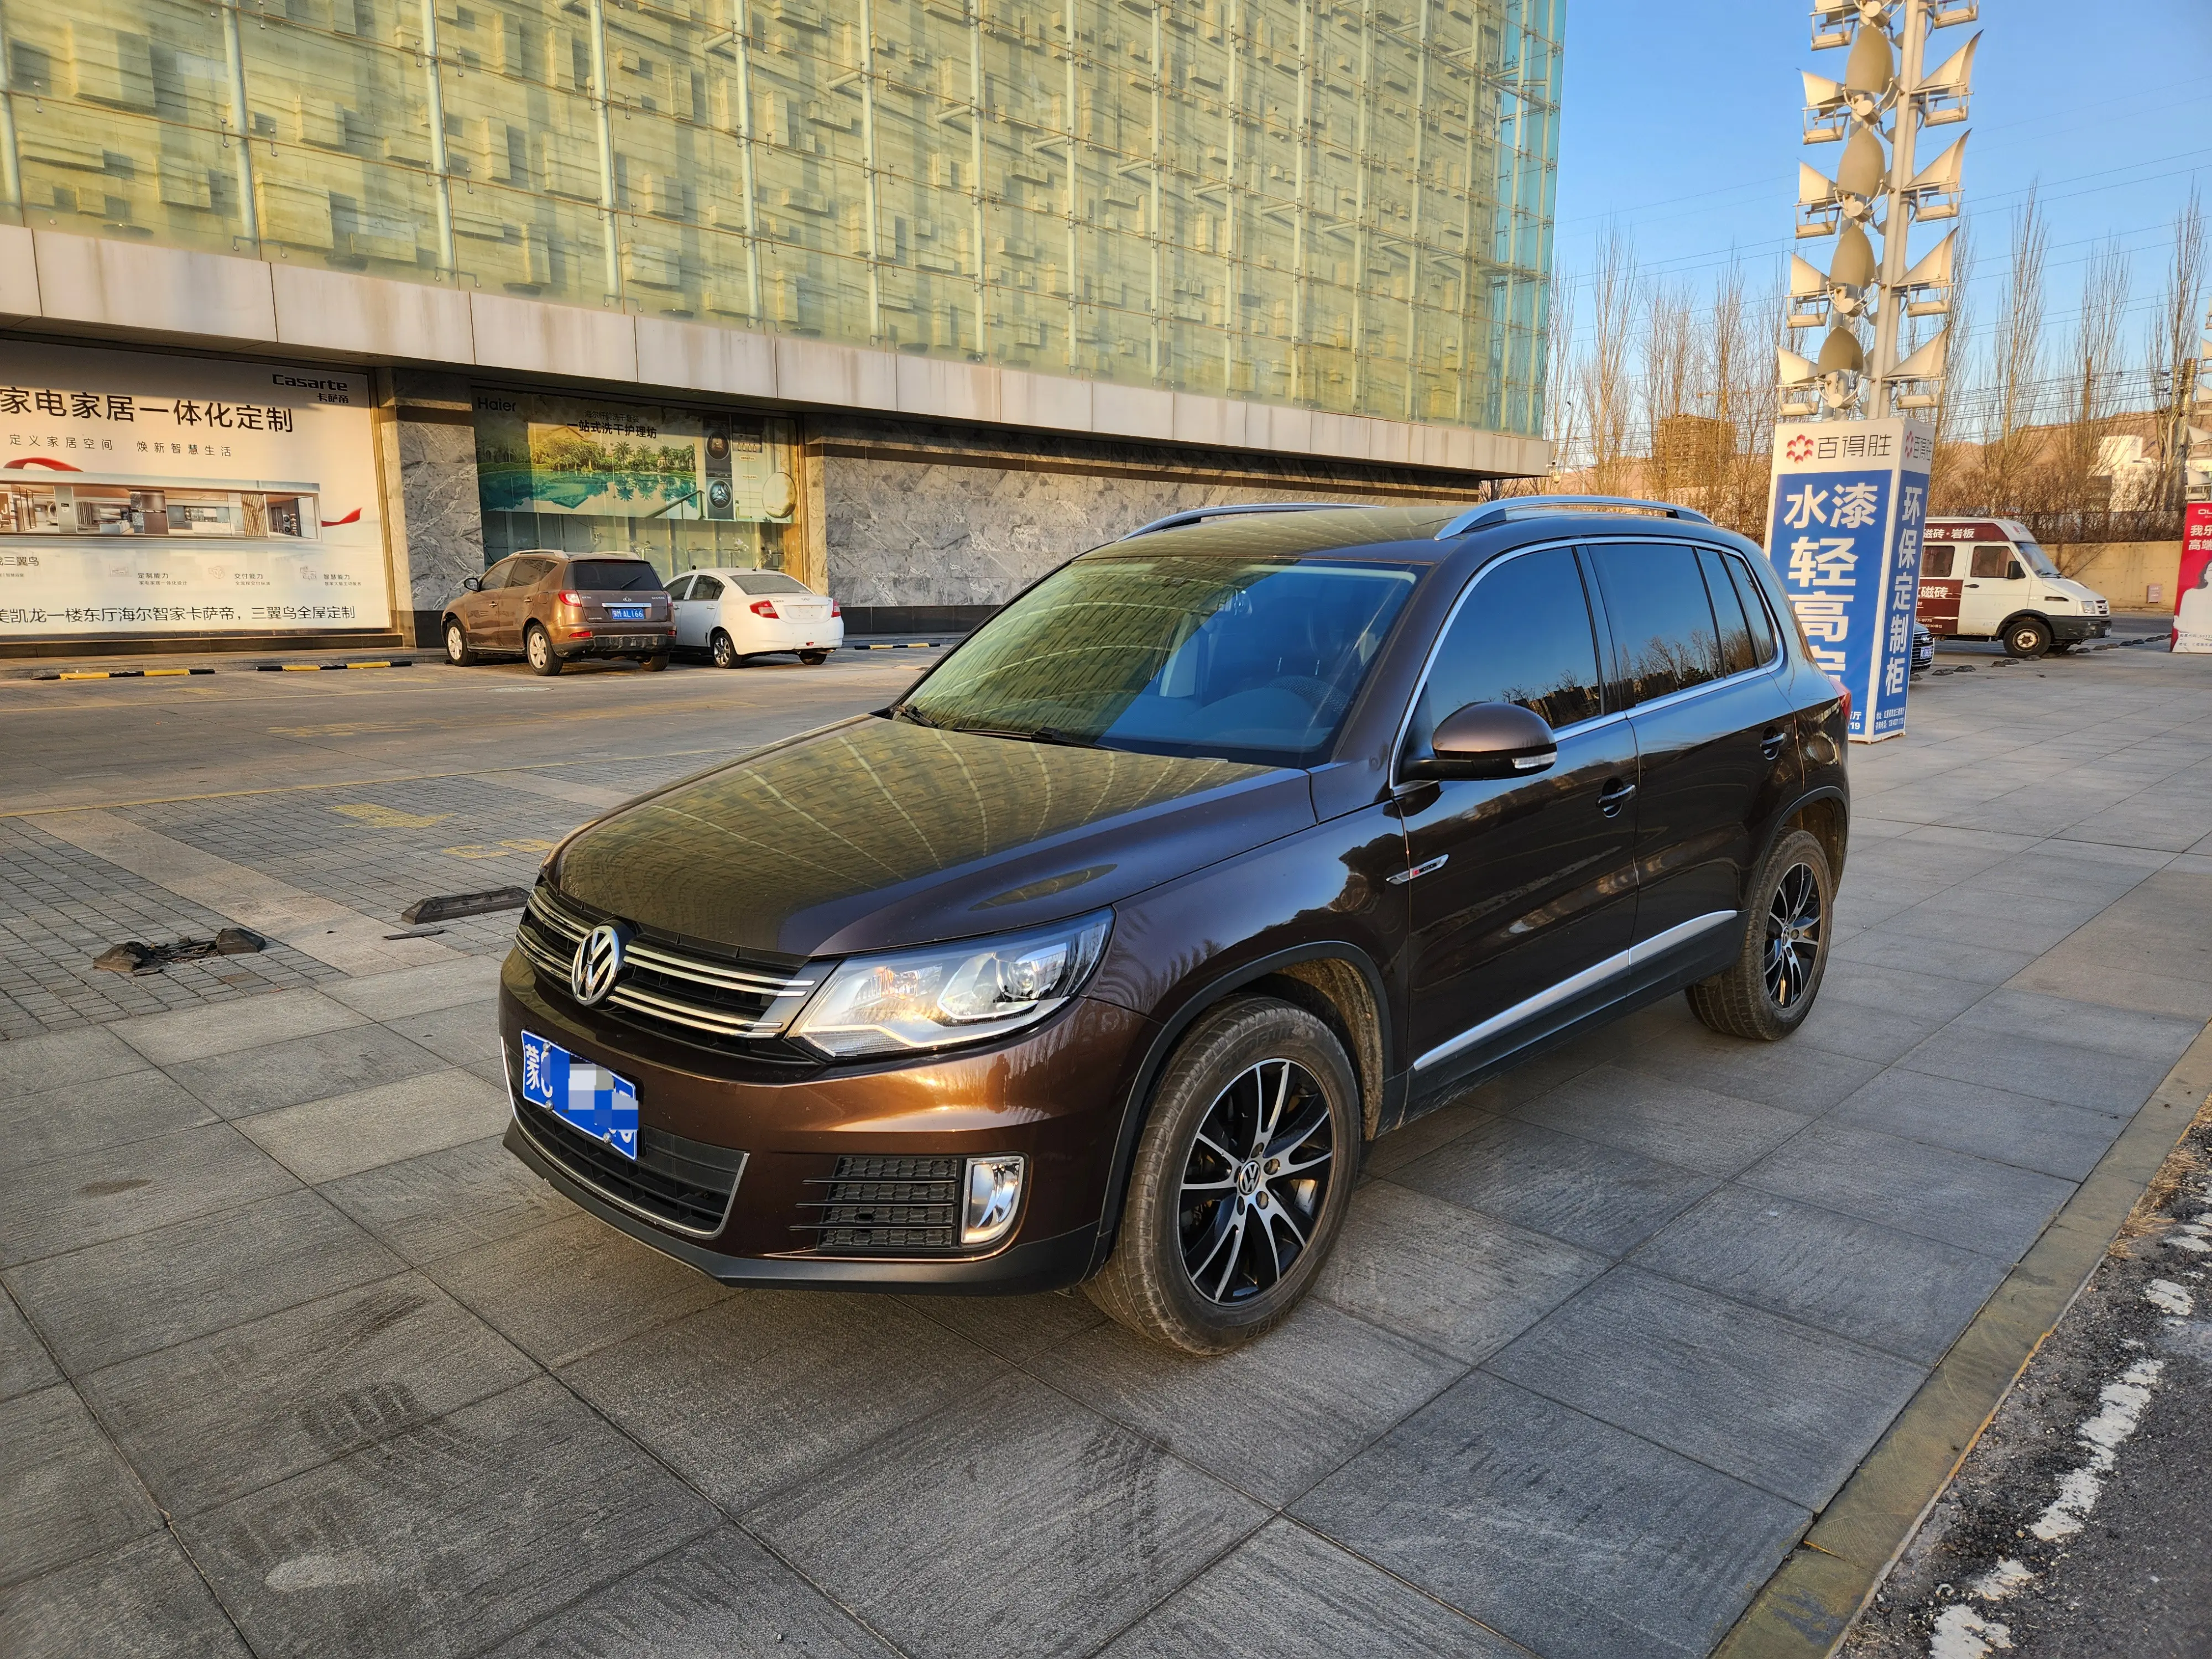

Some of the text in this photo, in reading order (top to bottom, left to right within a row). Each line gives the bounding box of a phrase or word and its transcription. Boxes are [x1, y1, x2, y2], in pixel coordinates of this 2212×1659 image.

[272, 374, 348, 391] Casarte
[0, 387, 293, 432] 家电家居一体化定制
[317, 393, 349, 404] 卡萨帝
[477, 397, 517, 412] Haier
[566, 419, 657, 439] 一站式洗干护理坊
[9, 434, 231, 457] 定义家居空间 焕新智慧生活
[1818, 434, 1892, 459] 百得胜
[1913, 436, 1932, 461] 百得胜
[1783, 482, 1878, 529] 水漆
[0, 556, 39, 566] 三翼鸟
[1886, 486, 1922, 696] 环保定制柜
